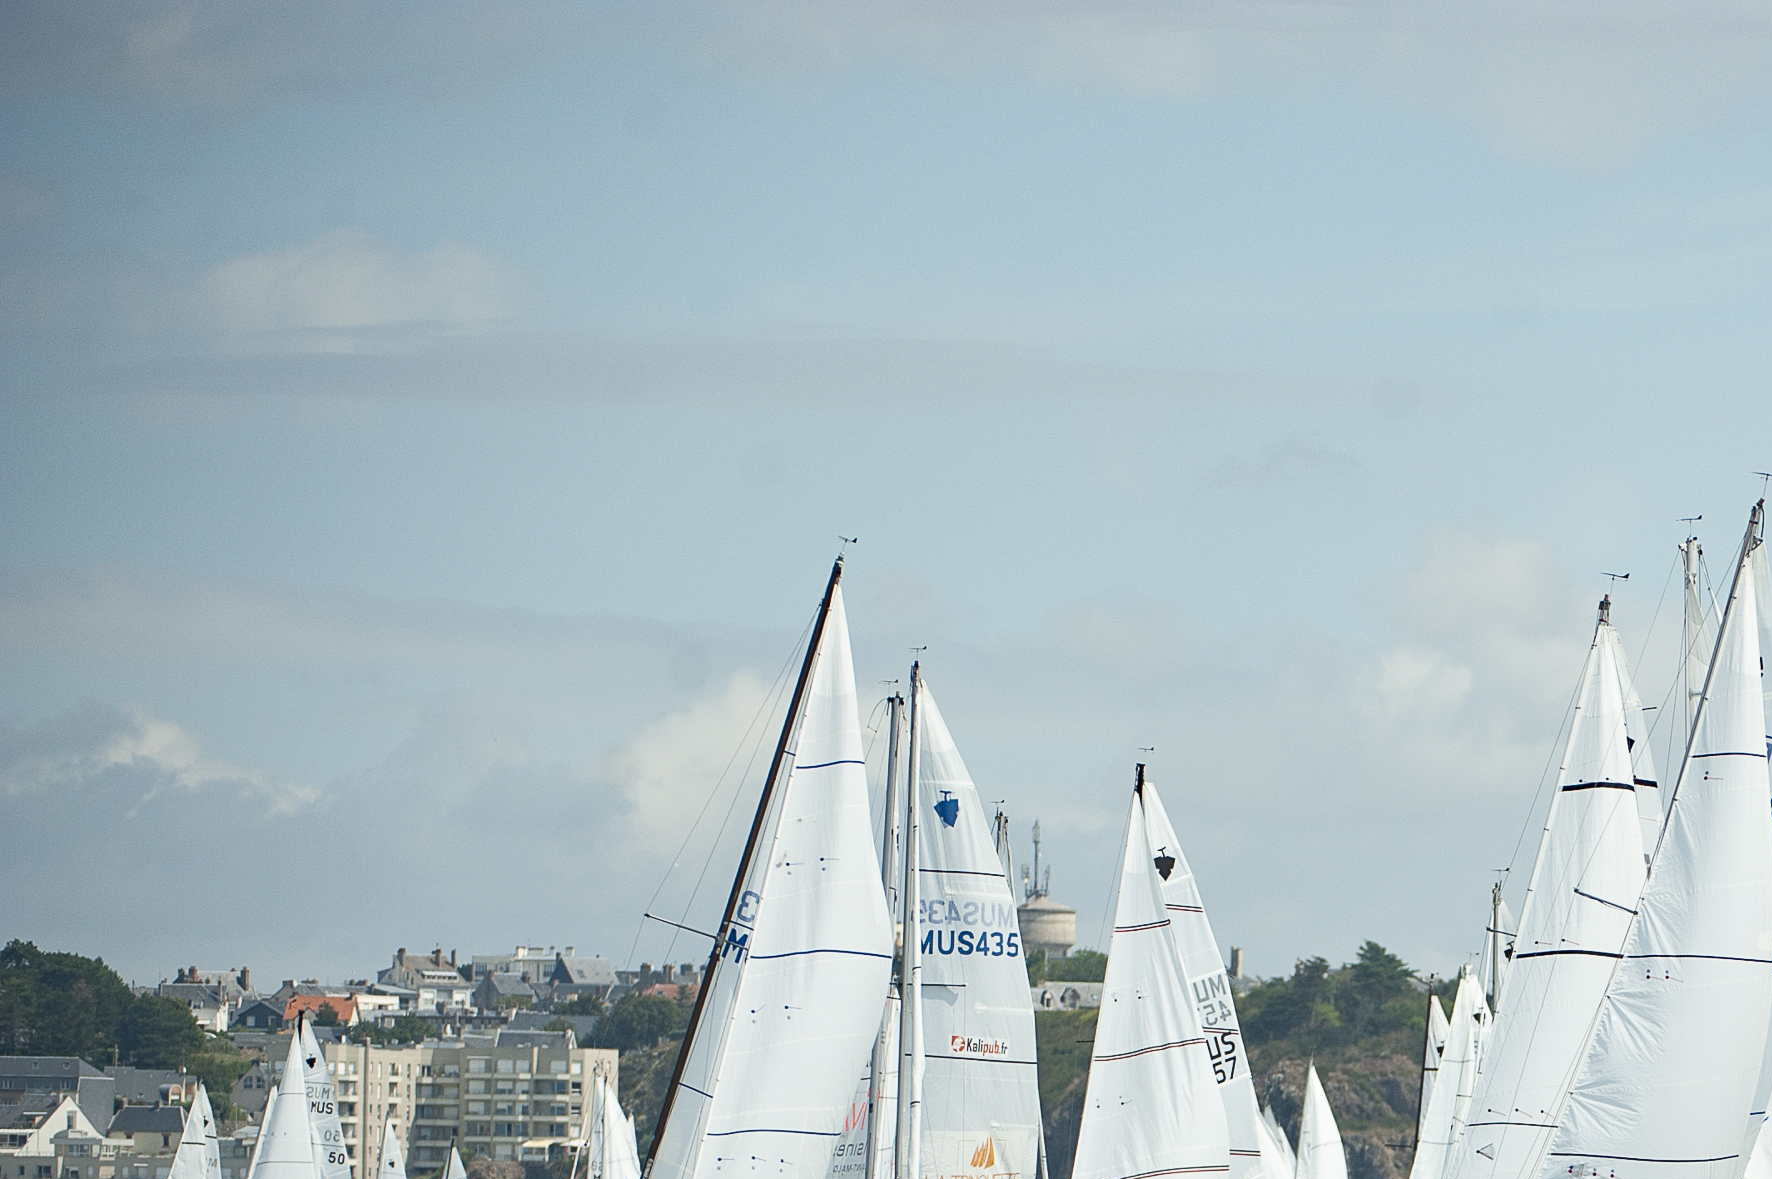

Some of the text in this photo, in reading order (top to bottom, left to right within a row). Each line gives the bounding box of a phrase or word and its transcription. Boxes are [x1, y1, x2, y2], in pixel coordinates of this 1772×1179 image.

[921, 929, 1019, 958] MUS435
[966, 1037, 1008, 1057] Kalipub.fr
[1206, 1031, 1236, 1061] US
[1212, 1055, 1237, 1085] 57
[310, 1101, 334, 1115] MUS
[328, 1151, 346, 1165] 50
